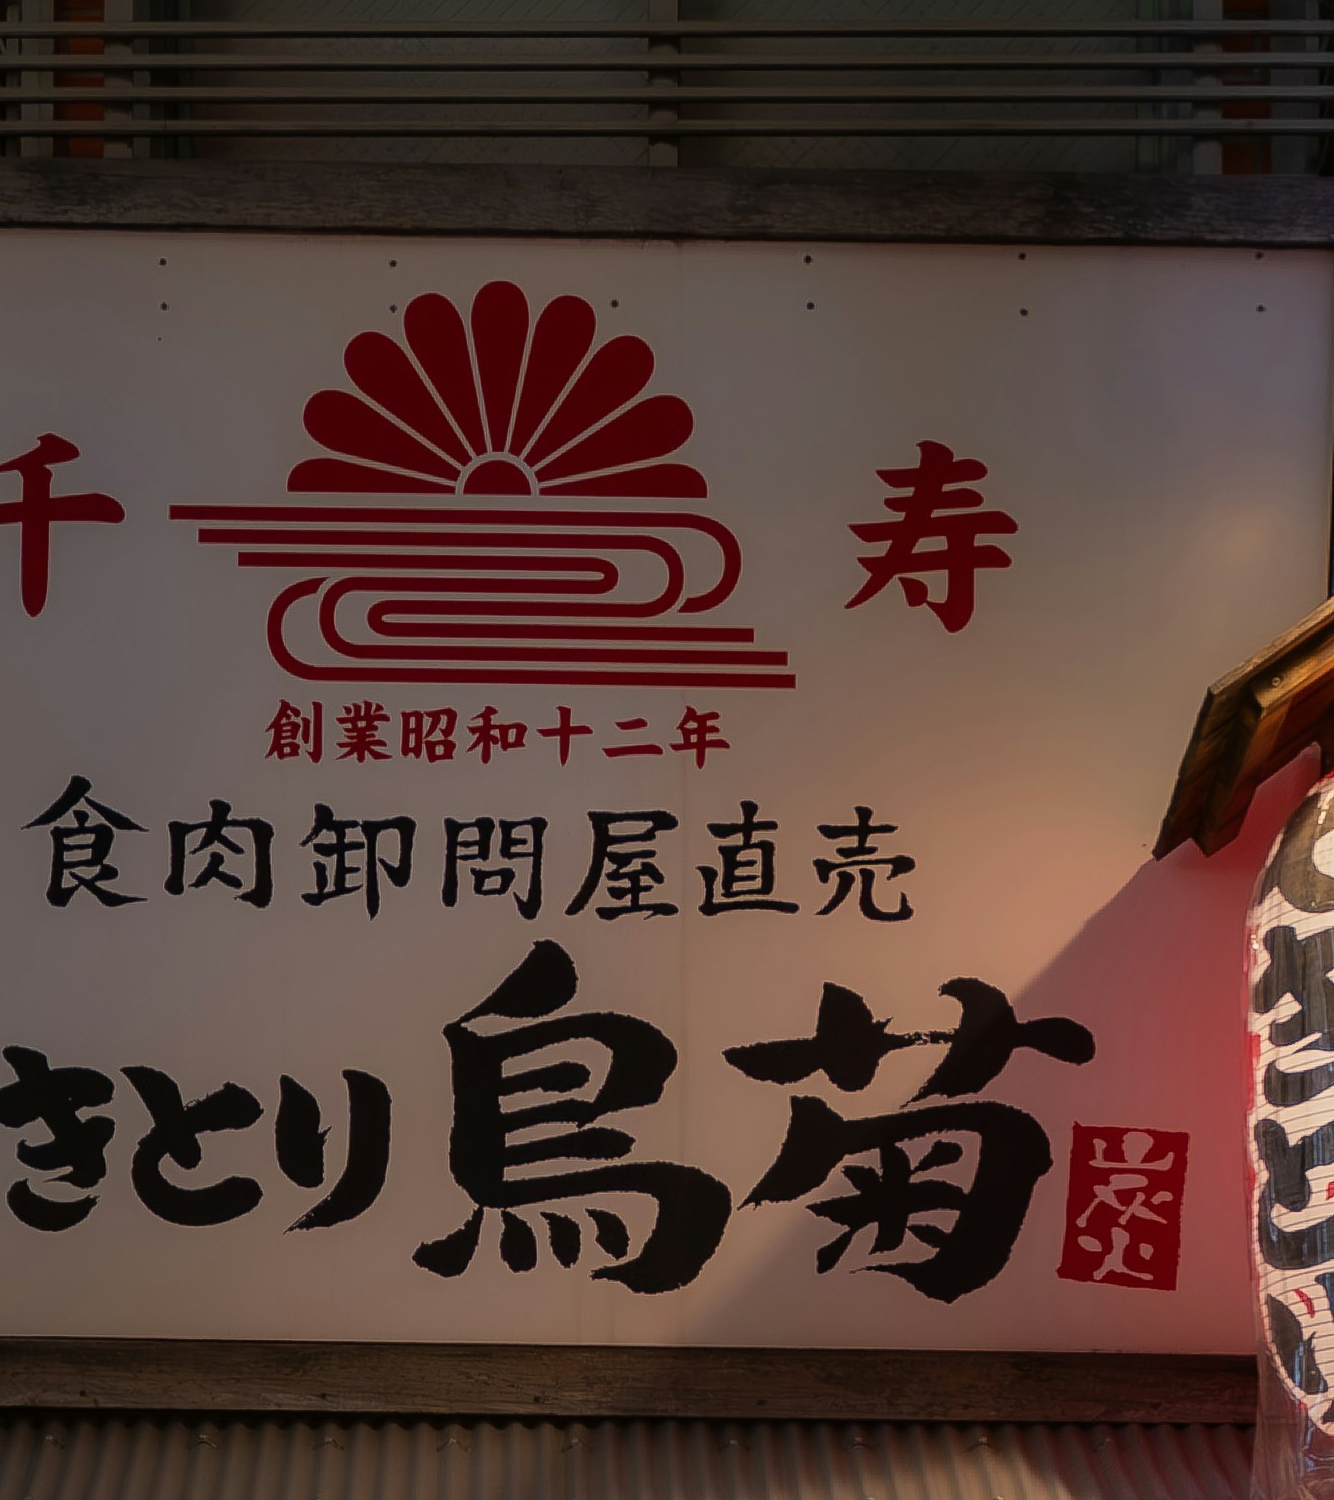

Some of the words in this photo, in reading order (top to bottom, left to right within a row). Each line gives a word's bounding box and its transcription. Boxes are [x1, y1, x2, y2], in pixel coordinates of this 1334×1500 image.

[844, 441, 1019, 634] 寿
[264, 699, 732, 770] 創業昭和十二年
[23, 775, 919, 925] 食肉卸問屋直売
[413, 938, 1096, 1305] 鳥菊
